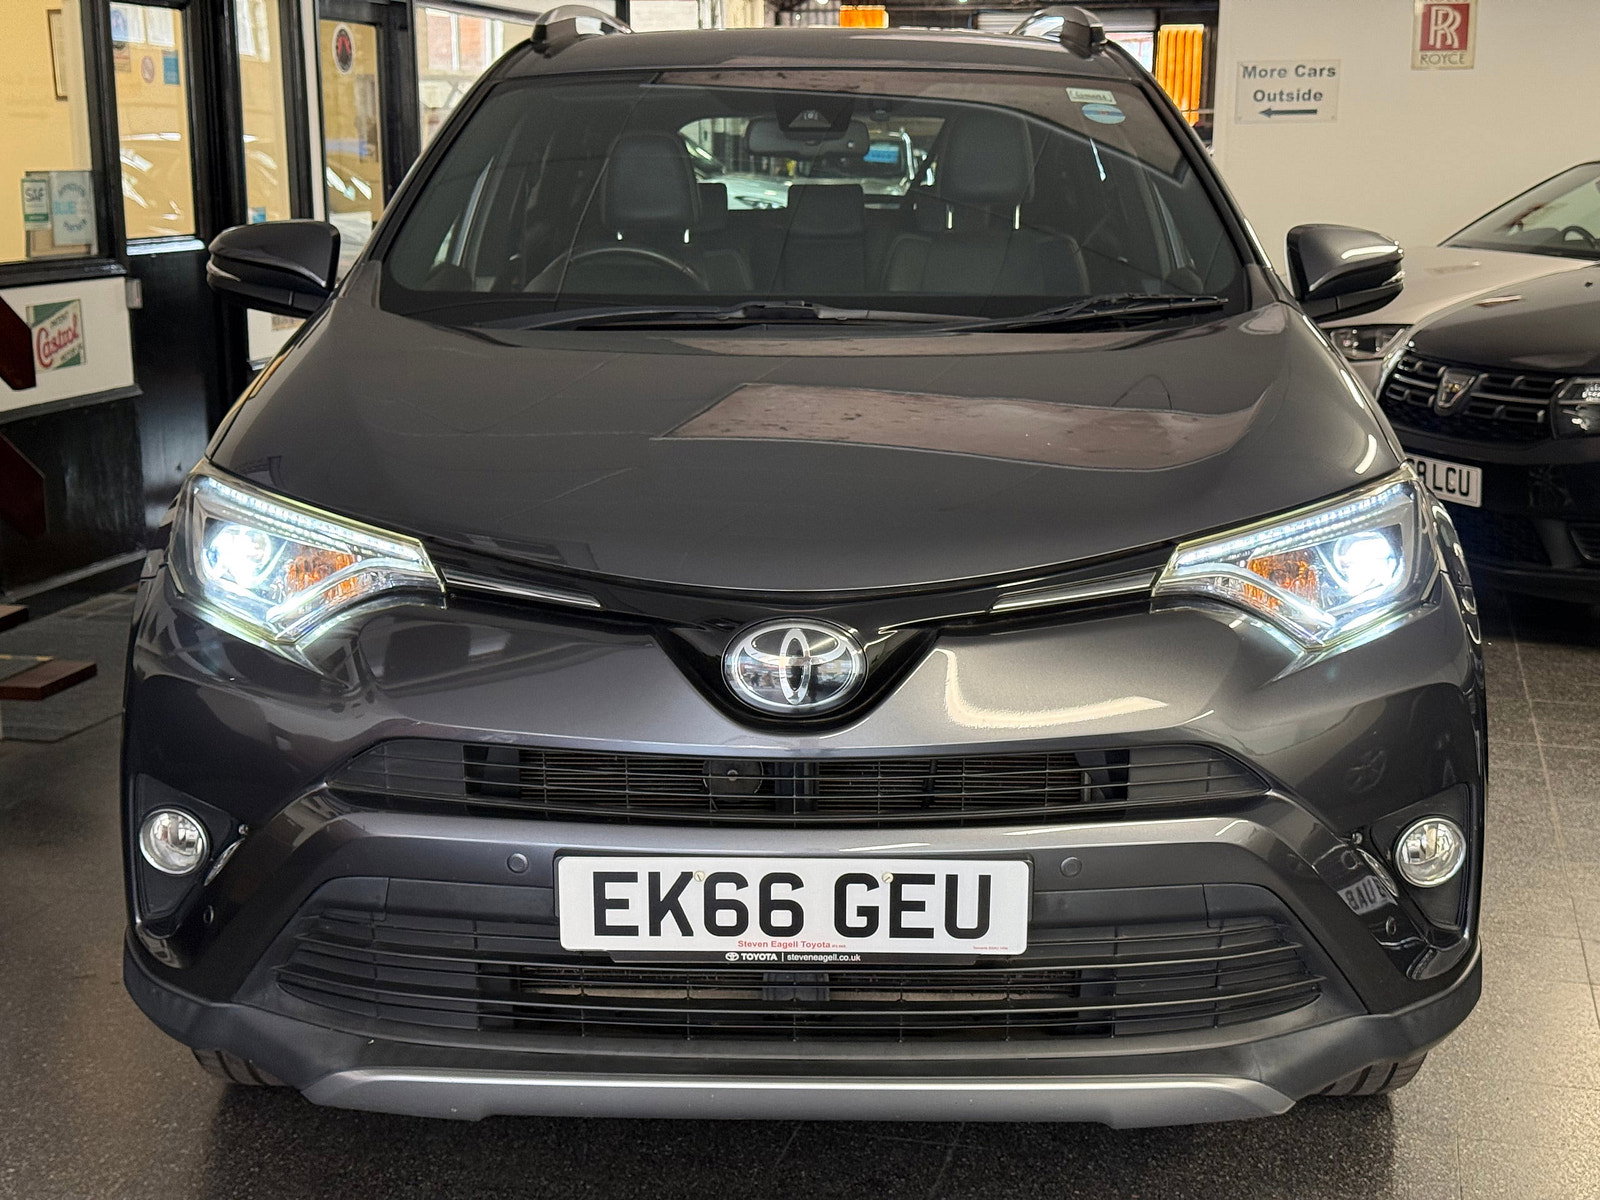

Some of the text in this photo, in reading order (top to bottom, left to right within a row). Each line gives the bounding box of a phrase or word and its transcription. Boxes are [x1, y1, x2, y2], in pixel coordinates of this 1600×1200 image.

[1420, 53, 1467, 65] ROYCE
[1242, 64, 1336, 79] More Cars
[1253, 88, 1323, 102] Outside
[36, 313, 79, 369] Castrol
[1432, 463, 1471, 498] LCU
[592, 871, 992, 942] EK66 GEU
[737, 940, 769, 949] Steven
[771, 940, 798, 950] Eagell
[801, 941, 831, 950] Toyota
[741, 953, 861, 963] TOYOTA steveneagell.co.uk
